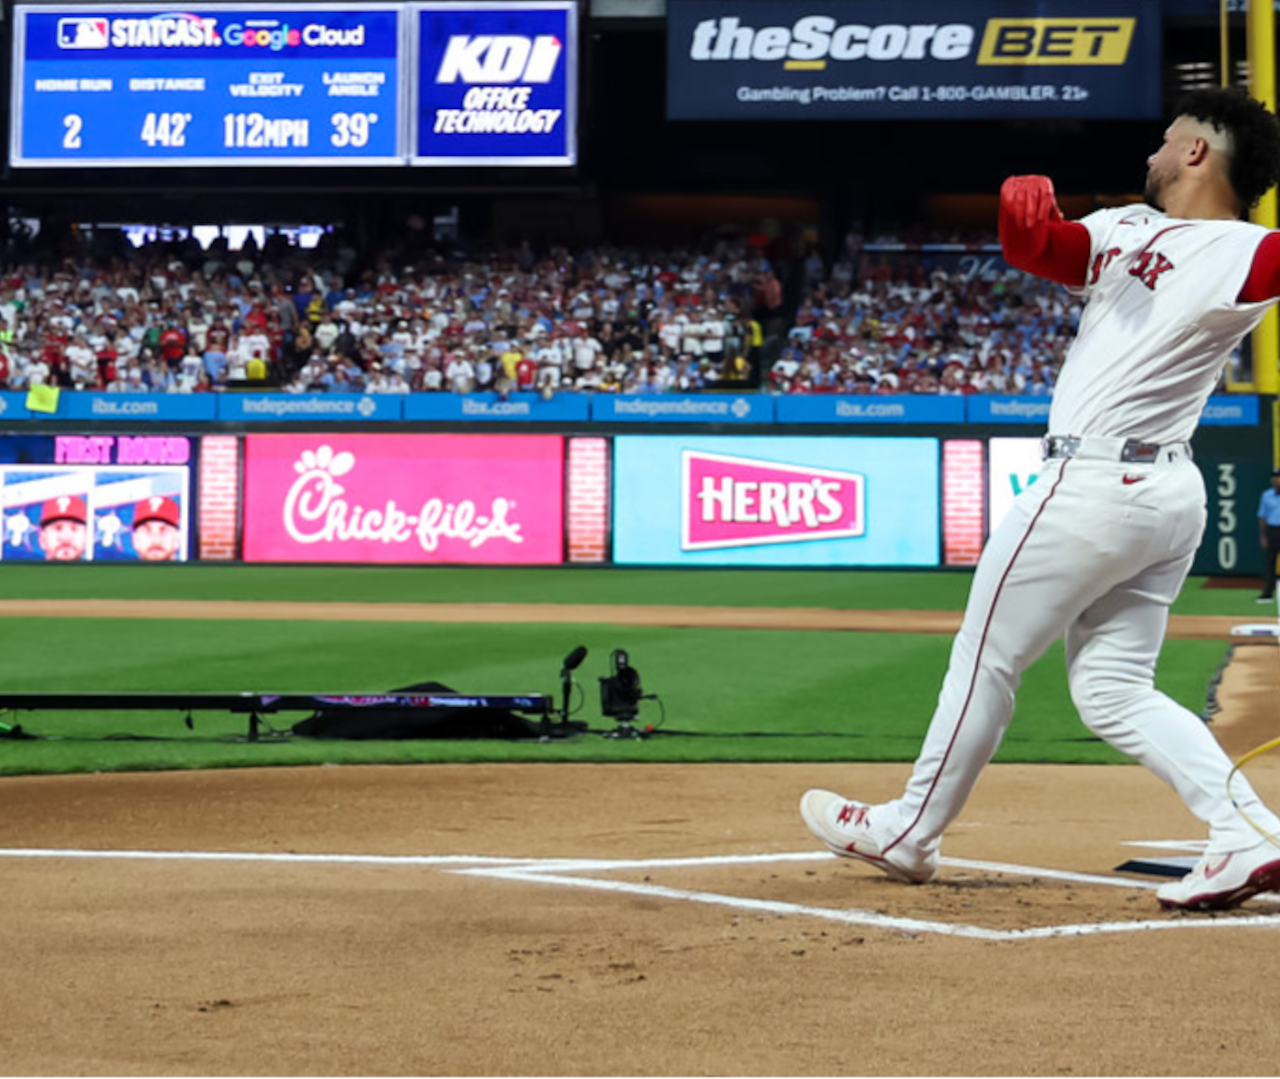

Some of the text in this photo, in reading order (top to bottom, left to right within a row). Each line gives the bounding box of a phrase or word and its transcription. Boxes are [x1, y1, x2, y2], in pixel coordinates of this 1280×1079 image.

[223, 24, 301, 51] Google
[302, 24, 365, 47] Cloud
[689, 15, 1121, 69] theScore BET
[435, 35, 562, 83] KDI
[35, 78, 113, 92] HOME RUN
[129, 77, 206, 91] DISTANCE
[249, 72, 285, 84] EXIT
[322, 71, 385, 84] LAUNCH
[229, 84, 304, 97] VELOCITY
[328, 84, 379, 97] ANGLE
[463, 86, 532, 110] OFFICE
[736, 86, 811, 104] Gambling
[813, 86, 885, 102] Problem?
[888, 86, 918, 101] Call
[223, 113, 309, 148] 112MPH
[433, 109, 562, 134] TECHNOLOGY
[63, 114, 82, 149] 2
[91, 398, 158, 415] ibx.com
[242, 398, 355, 416] Independence
[462, 399, 530, 416] ibx.com
[614, 399, 728, 417] Independence
[835, 399, 905, 418] ibx.com
[284, 448, 524, 550] Chick-fil-A
[697, 475, 843, 527] HERR'S
